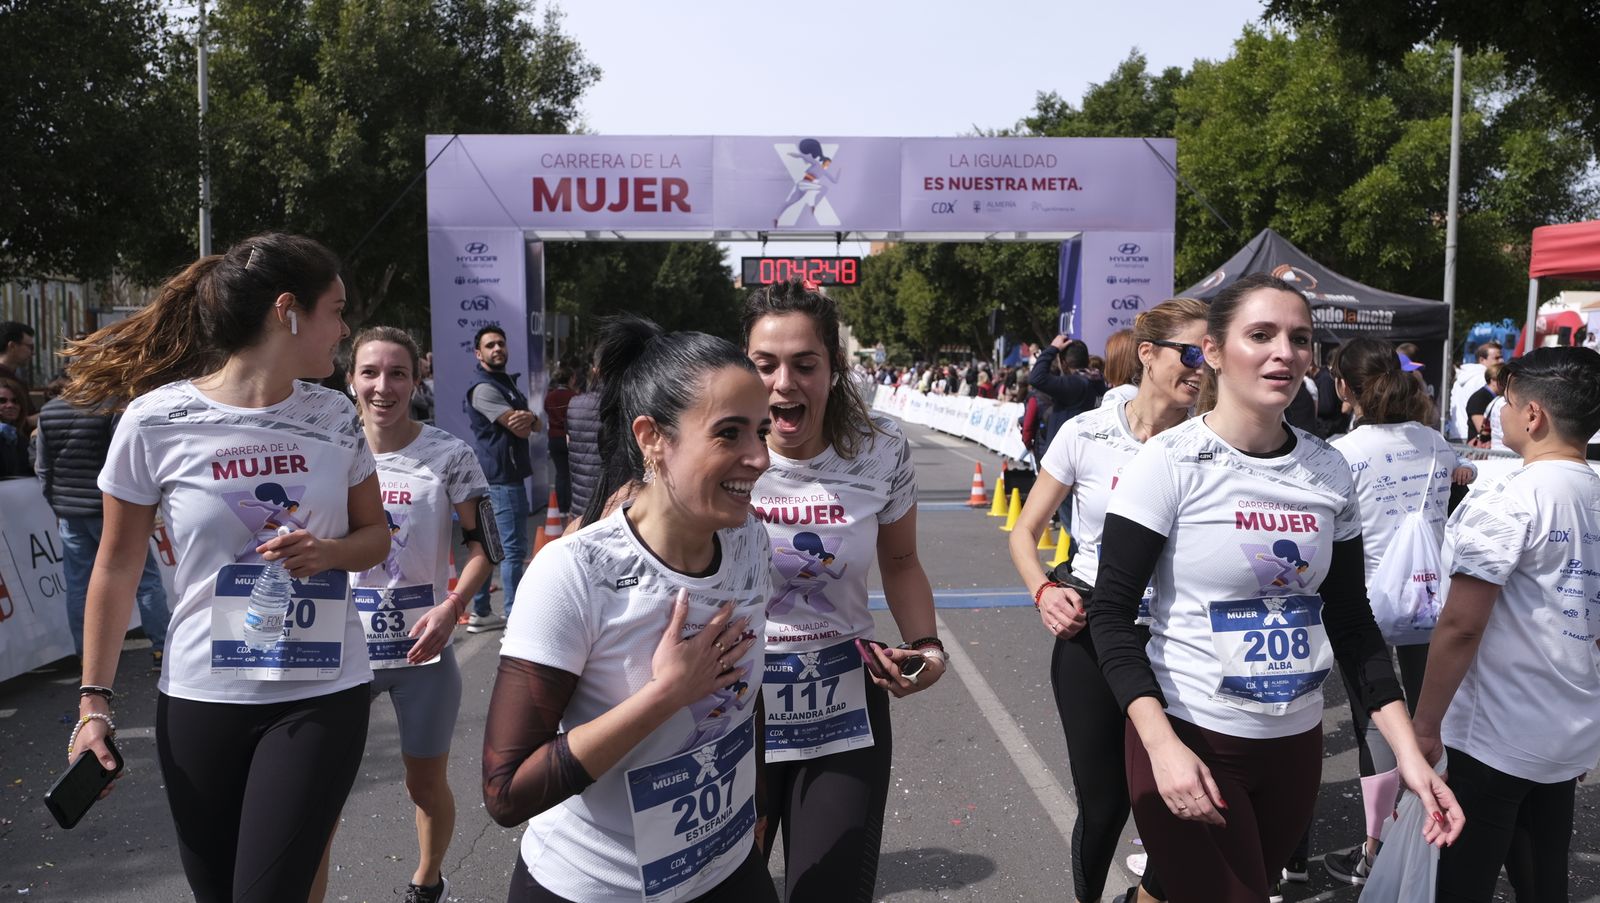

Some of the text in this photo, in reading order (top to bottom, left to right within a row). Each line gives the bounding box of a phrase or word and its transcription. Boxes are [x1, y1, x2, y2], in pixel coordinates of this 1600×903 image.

[540, 153, 682, 169] CARRERA DE LA
[950, 153, 1058, 169] LA IGUALDAD
[924, 177, 1083, 191] ES NUESTRA META.
[532, 177, 691, 213] MUJER
[931, 200, 958, 214] CDX
[467, 276, 501, 286] cajamar
[1119, 276, 1151, 286] cajamar
[215, 443, 299, 458] CARRERA DE LA
[211, 454, 309, 481] MUJER
[760, 492, 841, 505] CARRERA DE LA
[1238, 501, 1281, 511] CARRERA
[1283, 503, 1296, 511] DE
[755, 504, 848, 525] MUJER
[1235, 511, 1319, 533] MUJER
[1549, 528, 1571, 543] CDX
[371, 611, 406, 633] 63
[1227, 611, 1258, 620] MUJER
[779, 621, 830, 633] LA IGUALDAD
[779, 633, 820, 643] NUESTRA
[1243, 628, 1311, 662] 208
[764, 665, 793, 673] MUJER
[1267, 662, 1293, 671] ALBA
[776, 675, 840, 713] 117
[768, 709, 824, 721] ALEJANDRA
[826, 702, 847, 715] ABAD
[652, 771, 690, 791] MUJER
[671, 767, 737, 837] 207
[685, 806, 734, 843] ESTEFANIA
[670, 853, 687, 870] CDX
